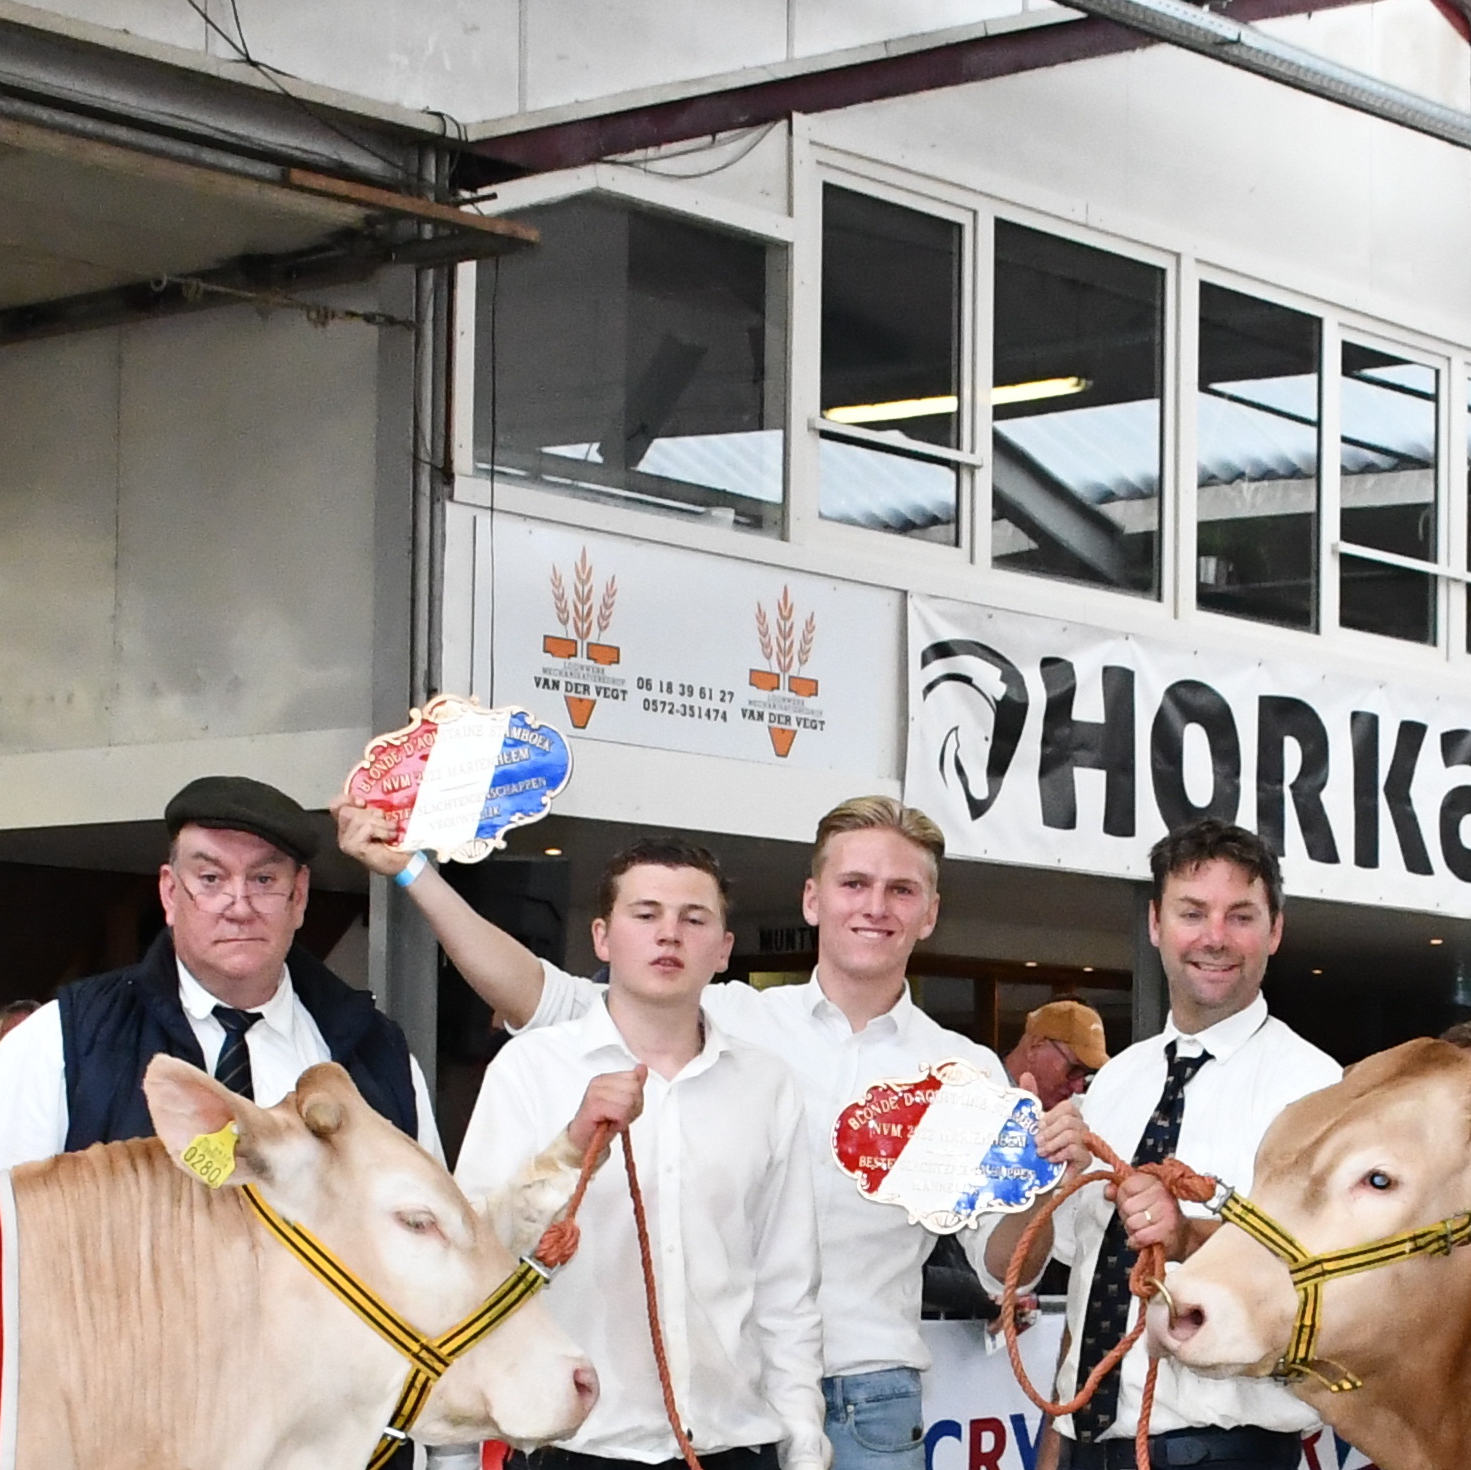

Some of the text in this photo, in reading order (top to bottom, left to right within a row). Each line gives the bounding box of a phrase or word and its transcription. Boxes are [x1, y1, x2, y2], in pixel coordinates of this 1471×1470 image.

[534, 676, 628, 701] VAN DER VEGT
[636, 676, 735, 704] 06 18 39 61 27
[642, 698, 728, 723] 0572-351474
[741, 707, 826, 731] VAN DER VEGT
[359, 752, 402, 793] BLONDE
[382, 774, 411, 794] NVM
[383, 808, 411, 822] ESTE
[848, 1097, 901, 1131] BLONDE
[183, 1146, 221, 1183] 0280
